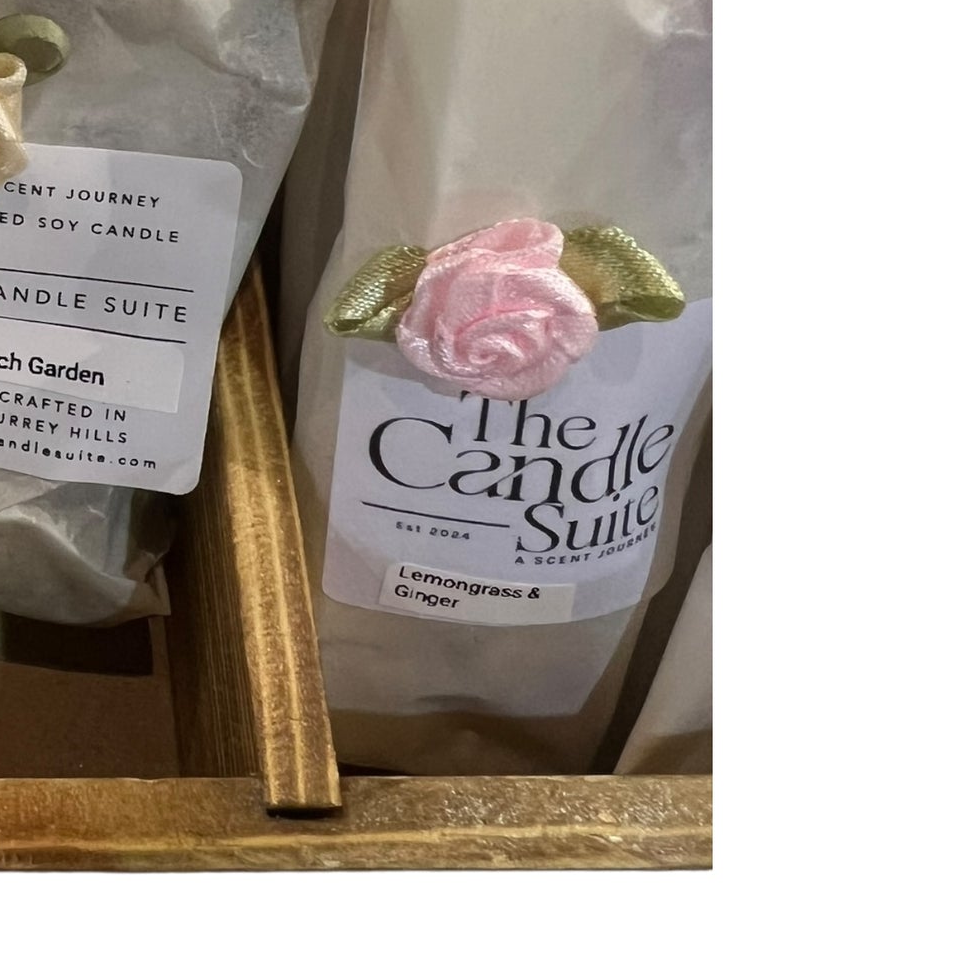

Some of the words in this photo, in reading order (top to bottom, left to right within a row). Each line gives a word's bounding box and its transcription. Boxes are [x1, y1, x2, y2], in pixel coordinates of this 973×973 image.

[3, 181, 57, 198] CENT
[66, 187, 161, 208] JOURNEY
[38, 216, 79, 232] SOY
[91, 222, 180, 243] CANDLE
[104, 297, 188, 324] SUITE
[28, 357, 105, 386] Garden
[105, 408, 127, 422] IN
[460, 390, 596, 450] The
[69, 426, 128, 444] HILLS
[368, 414, 675, 504] Candle
[396, 521, 422, 534] Est
[429, 526, 471, 541] 2024
[514, 483, 660, 554] Suite
[514, 555, 526, 565] A
[534, 552, 592, 566] SCENT
[394, 584, 460, 609] Ginger
[399, 566, 523, 600] Lemongrass
[527, 586, 541, 600] &
